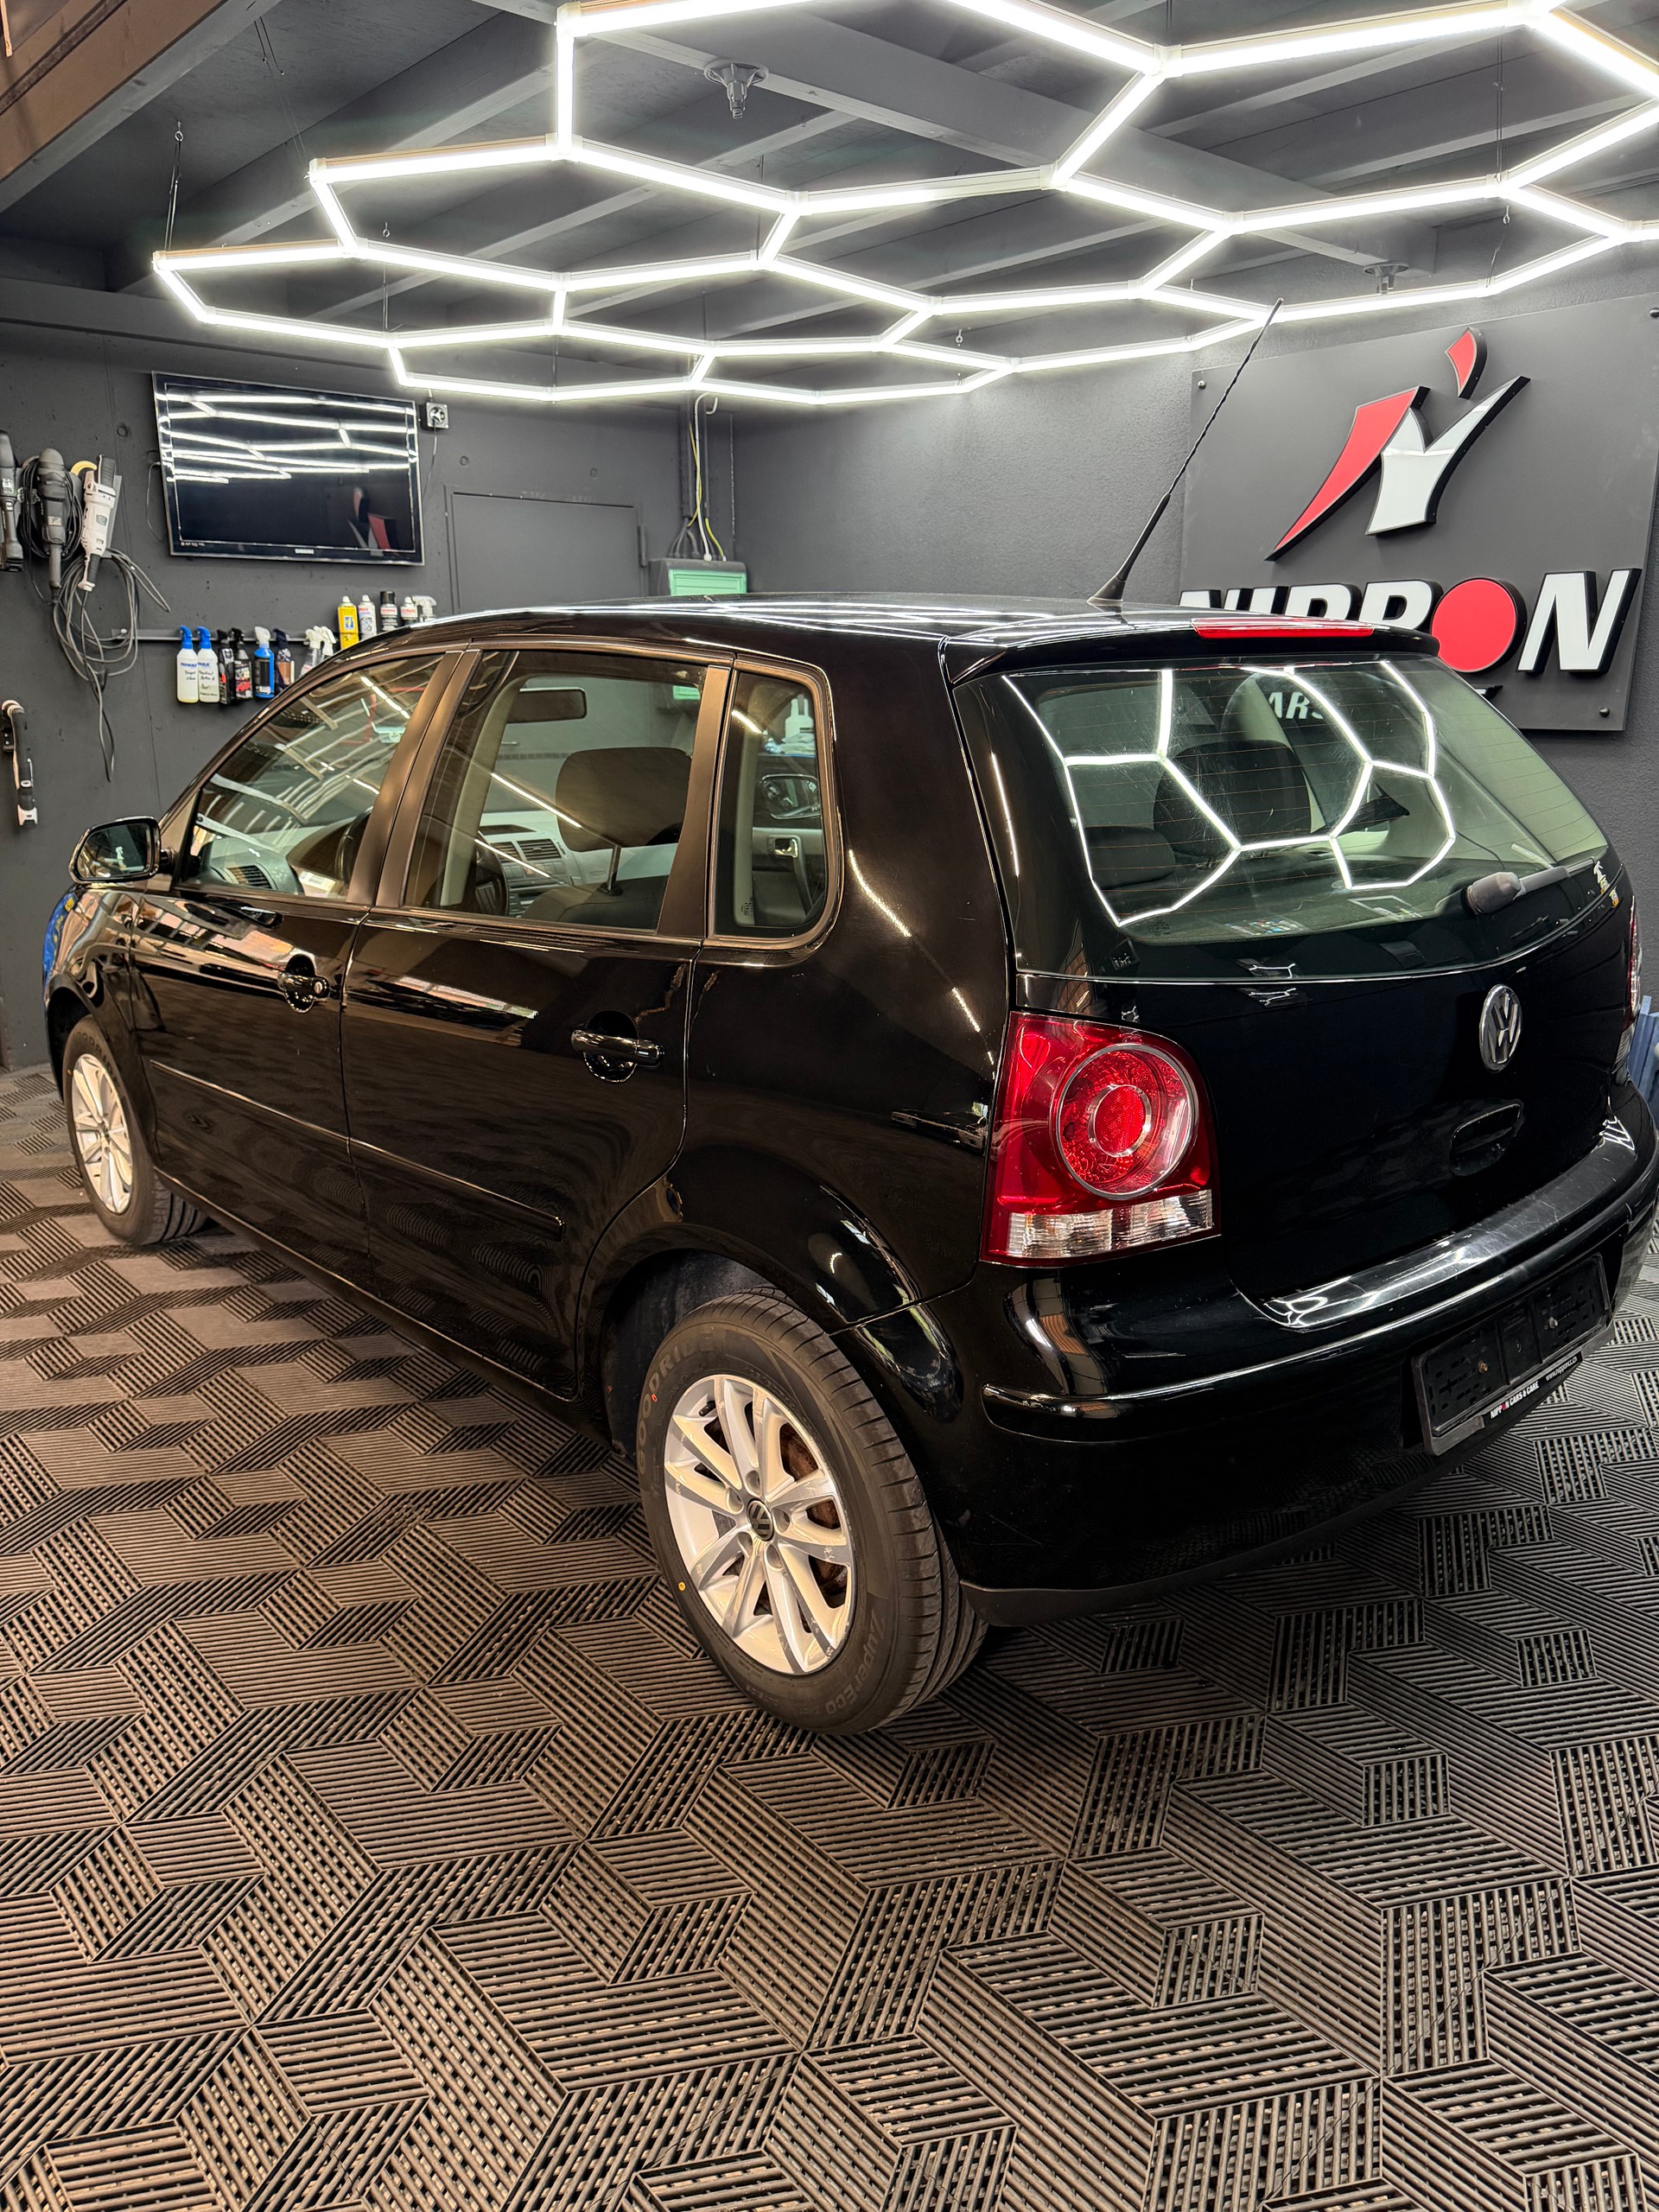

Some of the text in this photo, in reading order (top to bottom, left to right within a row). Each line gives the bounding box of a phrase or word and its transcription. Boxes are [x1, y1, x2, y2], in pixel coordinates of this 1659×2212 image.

[1179, 568, 1642, 673] PON
[638, 1332, 715, 1475] GOODRIDE
[1490, 1399, 1510, 1420] NIPPON
[1510, 1391, 1523, 1407] CARS
[1526, 1381, 1540, 1395] CARE
